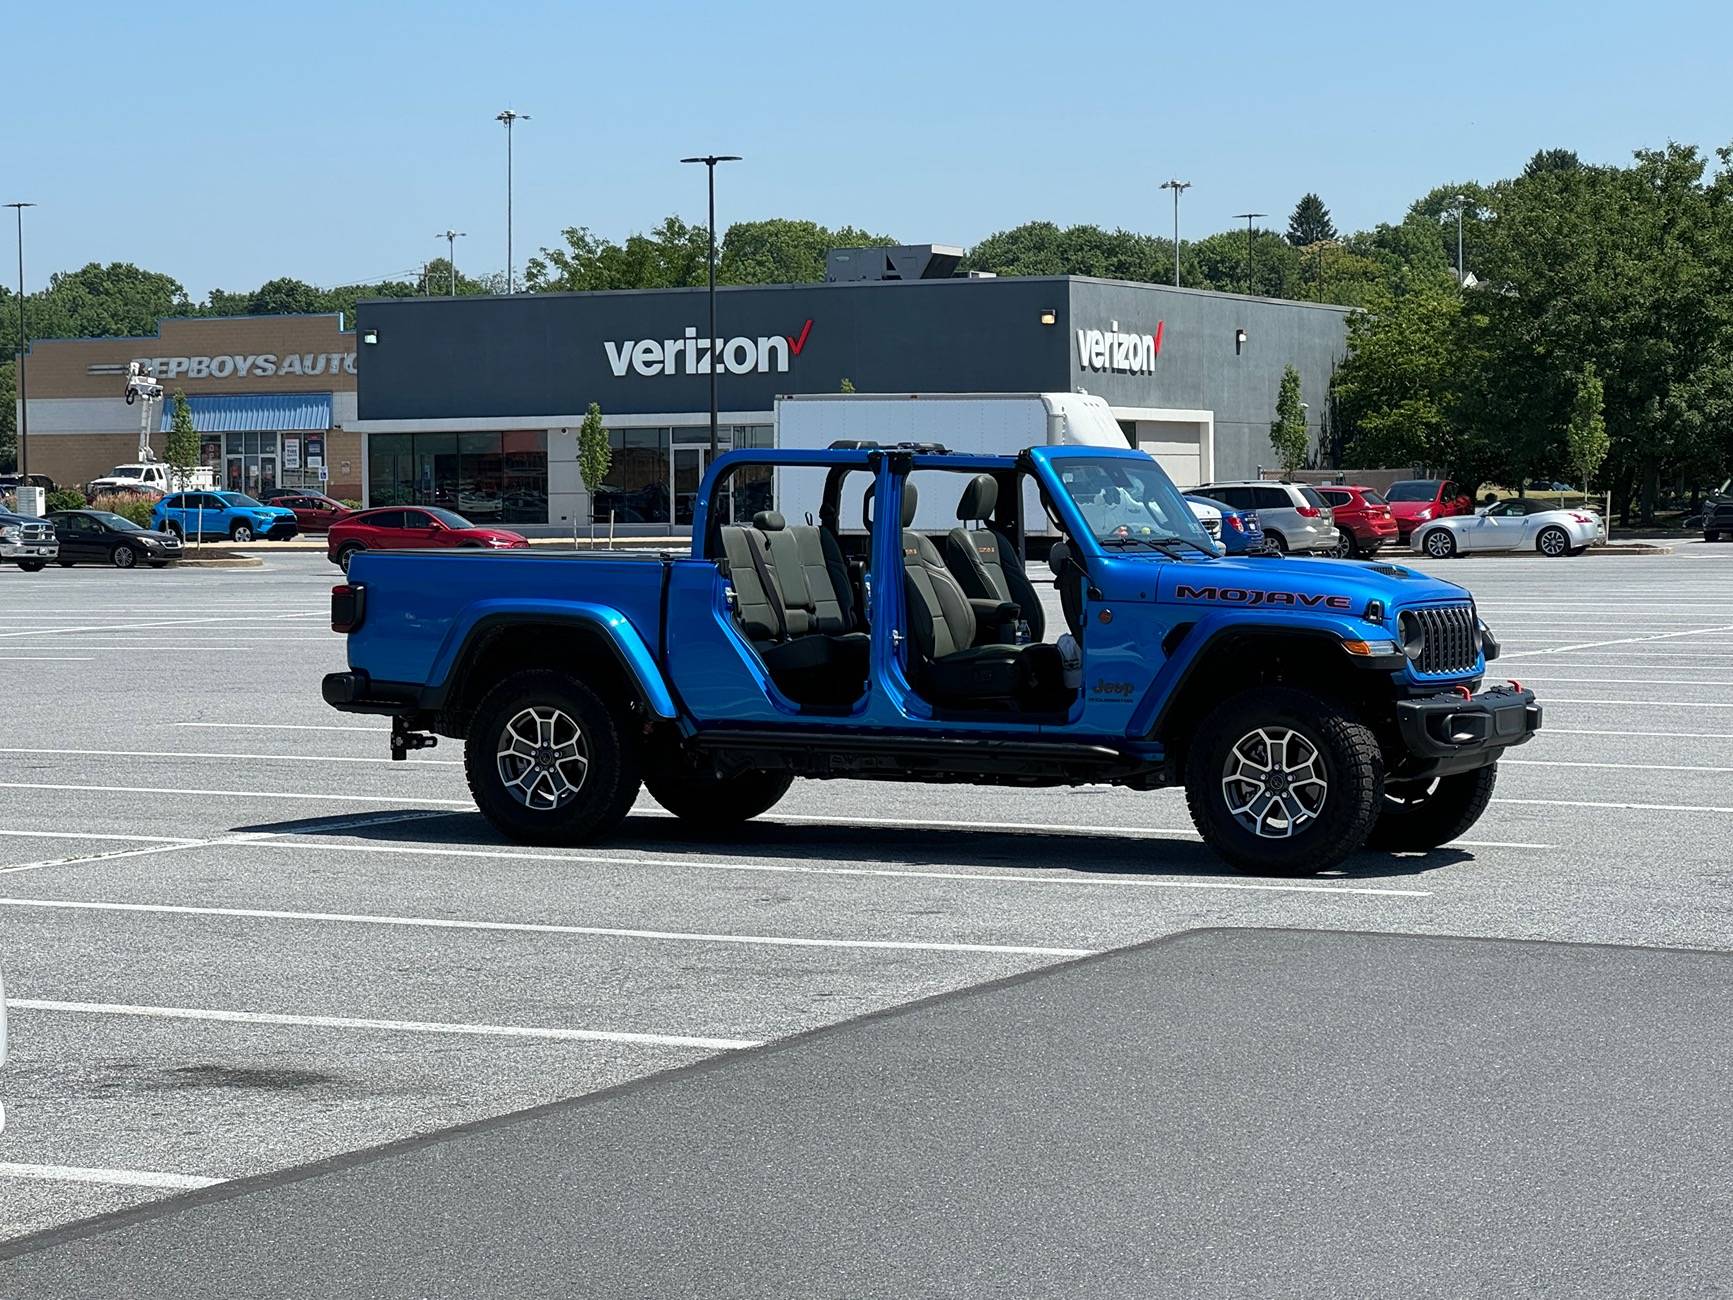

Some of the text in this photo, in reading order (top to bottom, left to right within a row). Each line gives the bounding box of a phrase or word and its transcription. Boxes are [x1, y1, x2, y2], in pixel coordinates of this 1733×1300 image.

[604, 326, 790, 377] verizon
[1075, 319, 1156, 373] verizon
[1175, 584, 1353, 610] MOJAVE
[1092, 677, 1136, 698] Jeep
